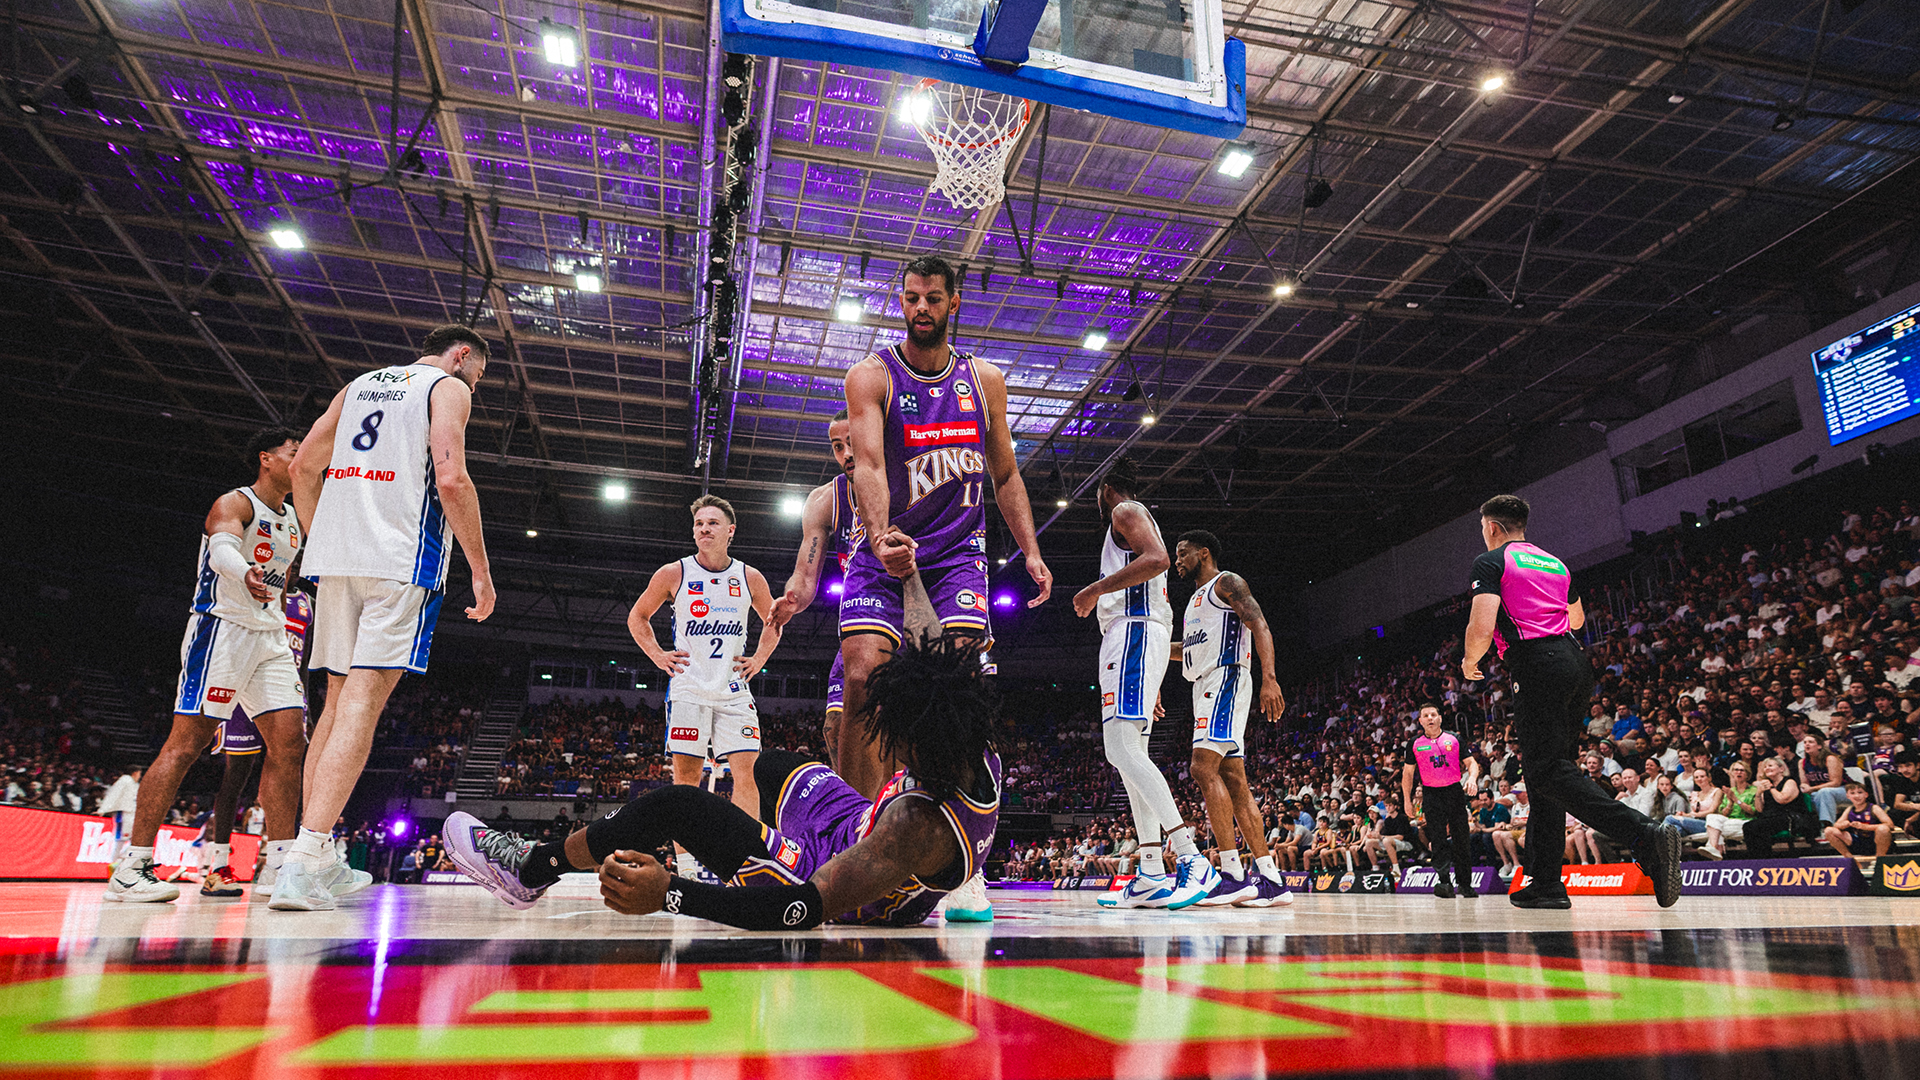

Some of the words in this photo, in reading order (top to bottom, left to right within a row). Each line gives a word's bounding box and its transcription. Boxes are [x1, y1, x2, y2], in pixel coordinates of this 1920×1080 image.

[368, 369, 417, 386] APEX
[351, 409, 385, 453] 8
[909, 429, 941, 440] Harvey
[941, 427, 977, 437] Norman
[904, 447, 984, 511] KINGS
[960, 481, 983, 508] 11
[256, 547, 272, 559] SKG
[692, 605, 707, 613] SKG
[710, 605, 738, 614] Services
[685, 619, 744, 637] Adelaide
[709, 637, 724, 660] 2
[1184, 650, 1193, 671] 11
[1566, 872, 1624, 888] Norman
[1680, 869, 1718, 887] UILT
[1718, 868, 1754, 887] FOR
[1755, 867, 1845, 887] SYDNEY
